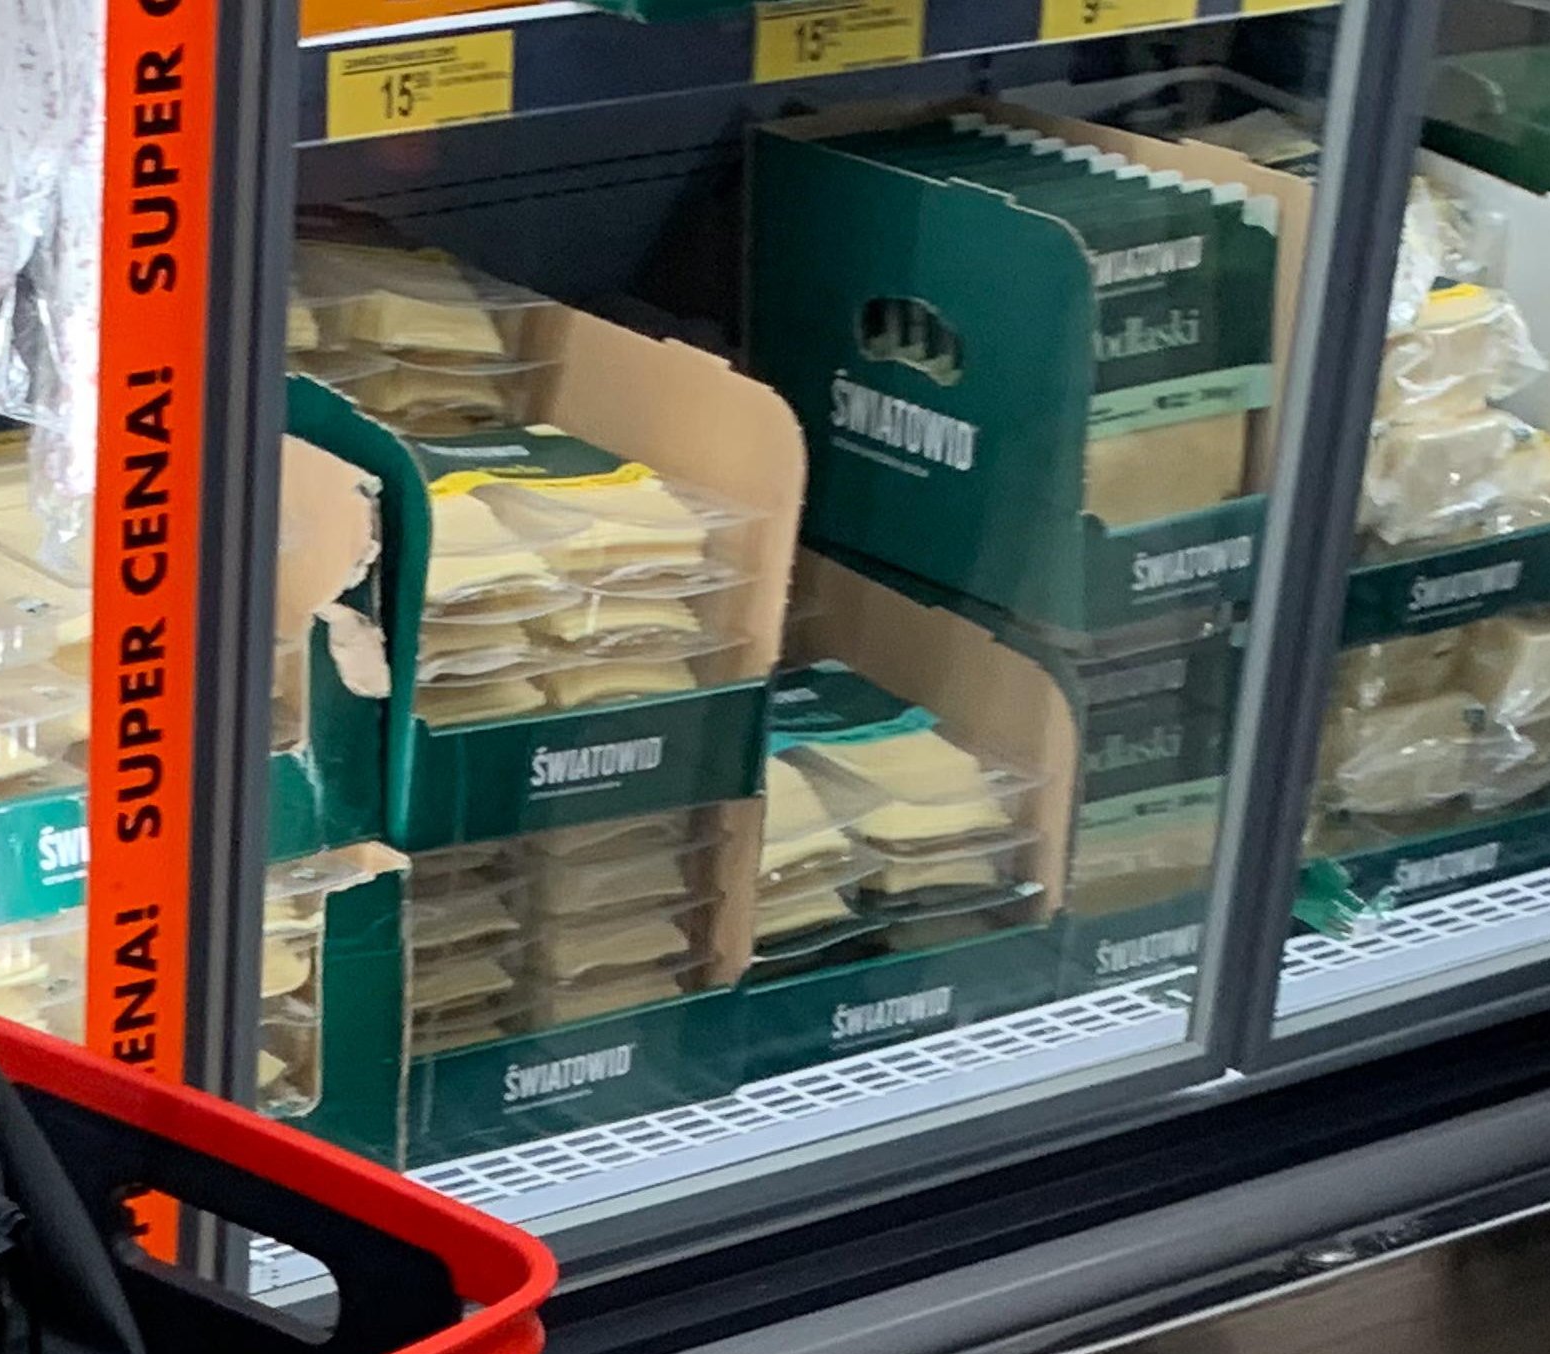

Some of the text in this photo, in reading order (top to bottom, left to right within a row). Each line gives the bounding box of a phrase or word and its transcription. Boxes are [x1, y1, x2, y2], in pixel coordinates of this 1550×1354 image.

[380, 73, 415, 119] 15
[128, 43, 186, 295] SUPER
[830, 367, 978, 472] ŚWIATOWID
[120, 365, 175, 596] CENA!
[117, 616, 166, 844] SUPER
[530, 736, 664, 787] ŚWIATOWID
[38, 825, 91, 871] ŚWI
[112, 903, 160, 1073] ENA!
[831, 985, 954, 1039] ŚWIATOWID
[503, 1042, 636, 1101] ŚWIATOWID
